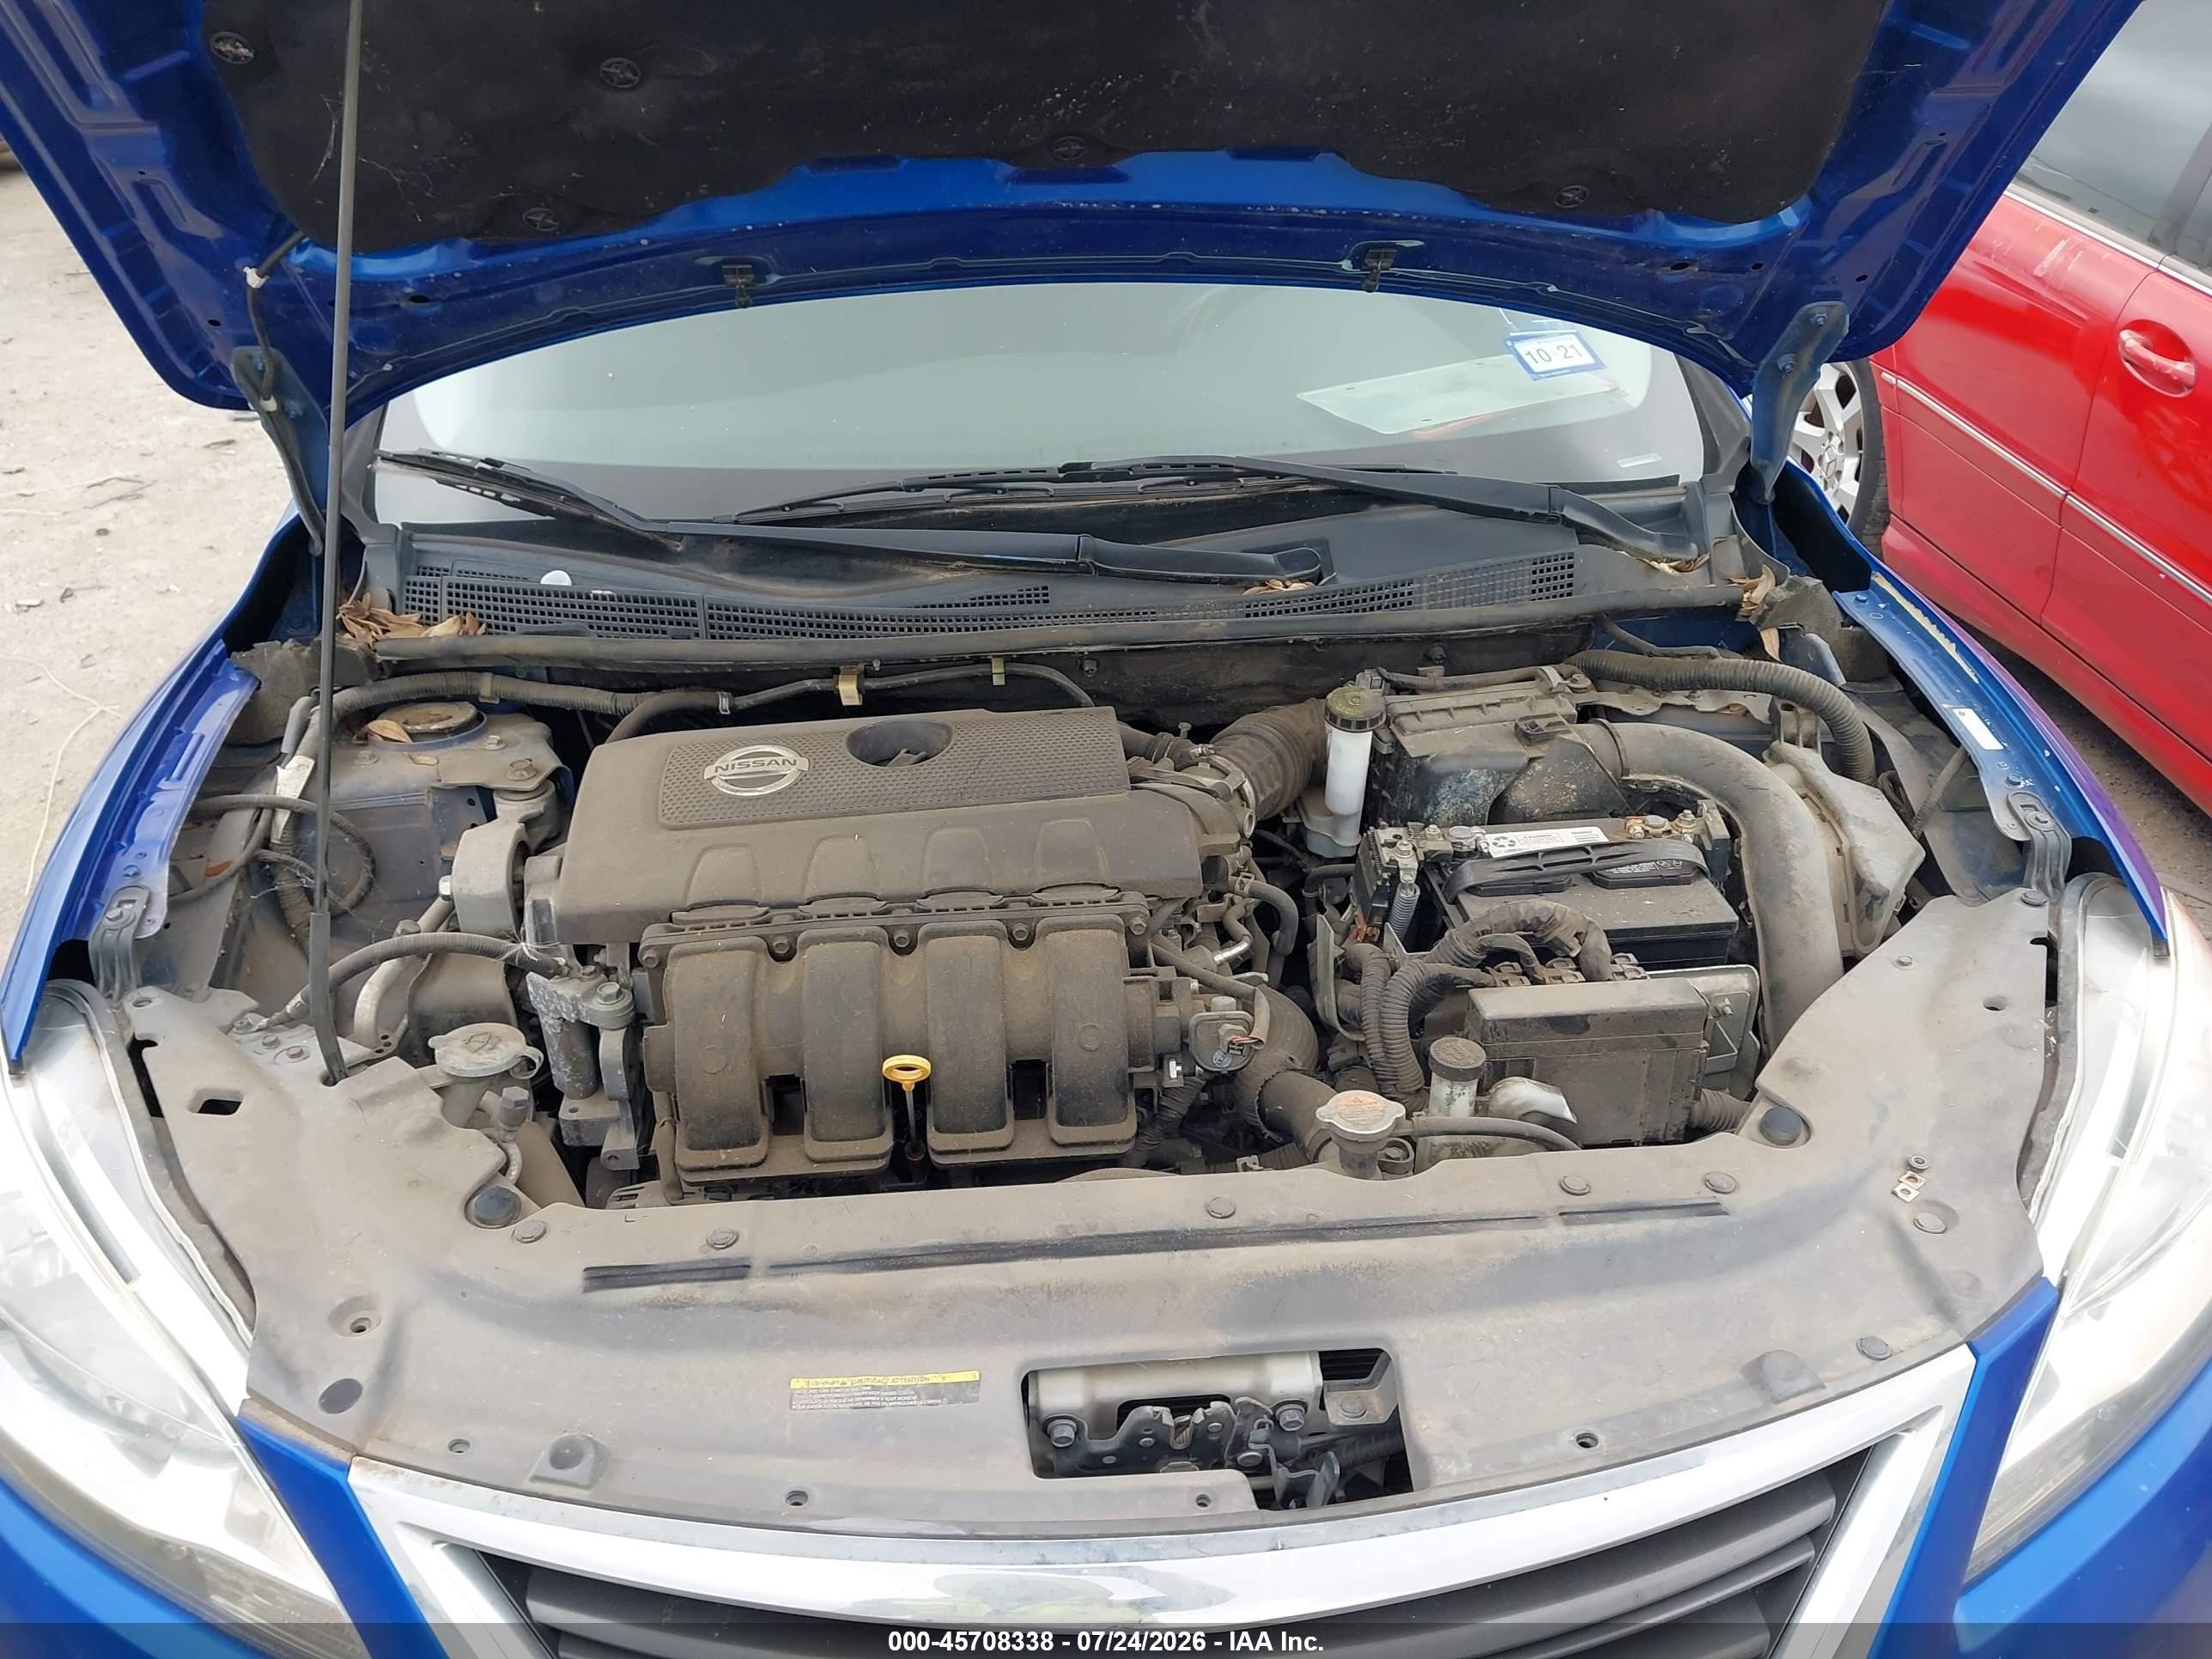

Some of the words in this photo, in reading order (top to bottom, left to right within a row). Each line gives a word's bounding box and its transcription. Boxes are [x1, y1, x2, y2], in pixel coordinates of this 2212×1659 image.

[1525, 349, 1552, 363] 10
[1557, 345, 1583, 359] 21
[715, 759, 797, 773] NISSAN
